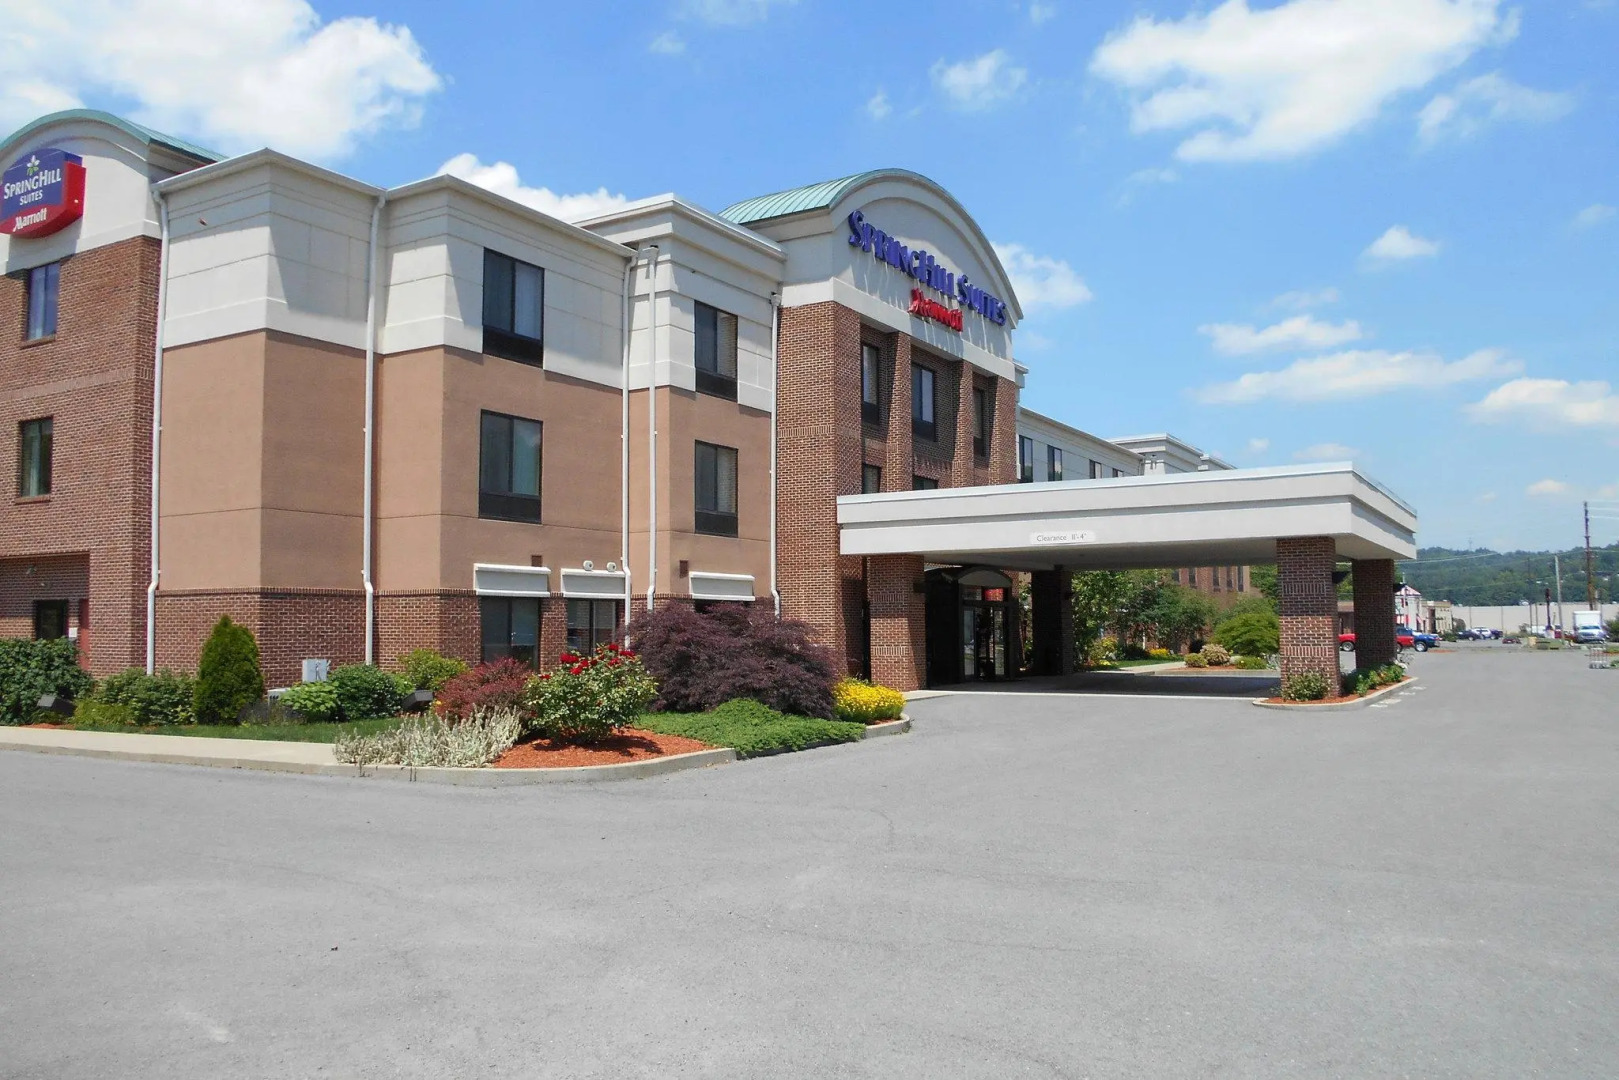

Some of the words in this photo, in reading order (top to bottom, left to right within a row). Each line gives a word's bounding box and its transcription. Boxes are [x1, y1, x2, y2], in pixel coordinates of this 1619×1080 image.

[4, 168, 61, 199] SPRINGHILL
[20, 190, 43, 205] SUITES
[13, 207, 47, 232] Marriott
[848, 210, 954, 299] SPRINGHILL
[957, 274, 1006, 326] SUITES
[908, 288, 963, 332] Marriott
[1036, 534, 1067, 542] Clearance
